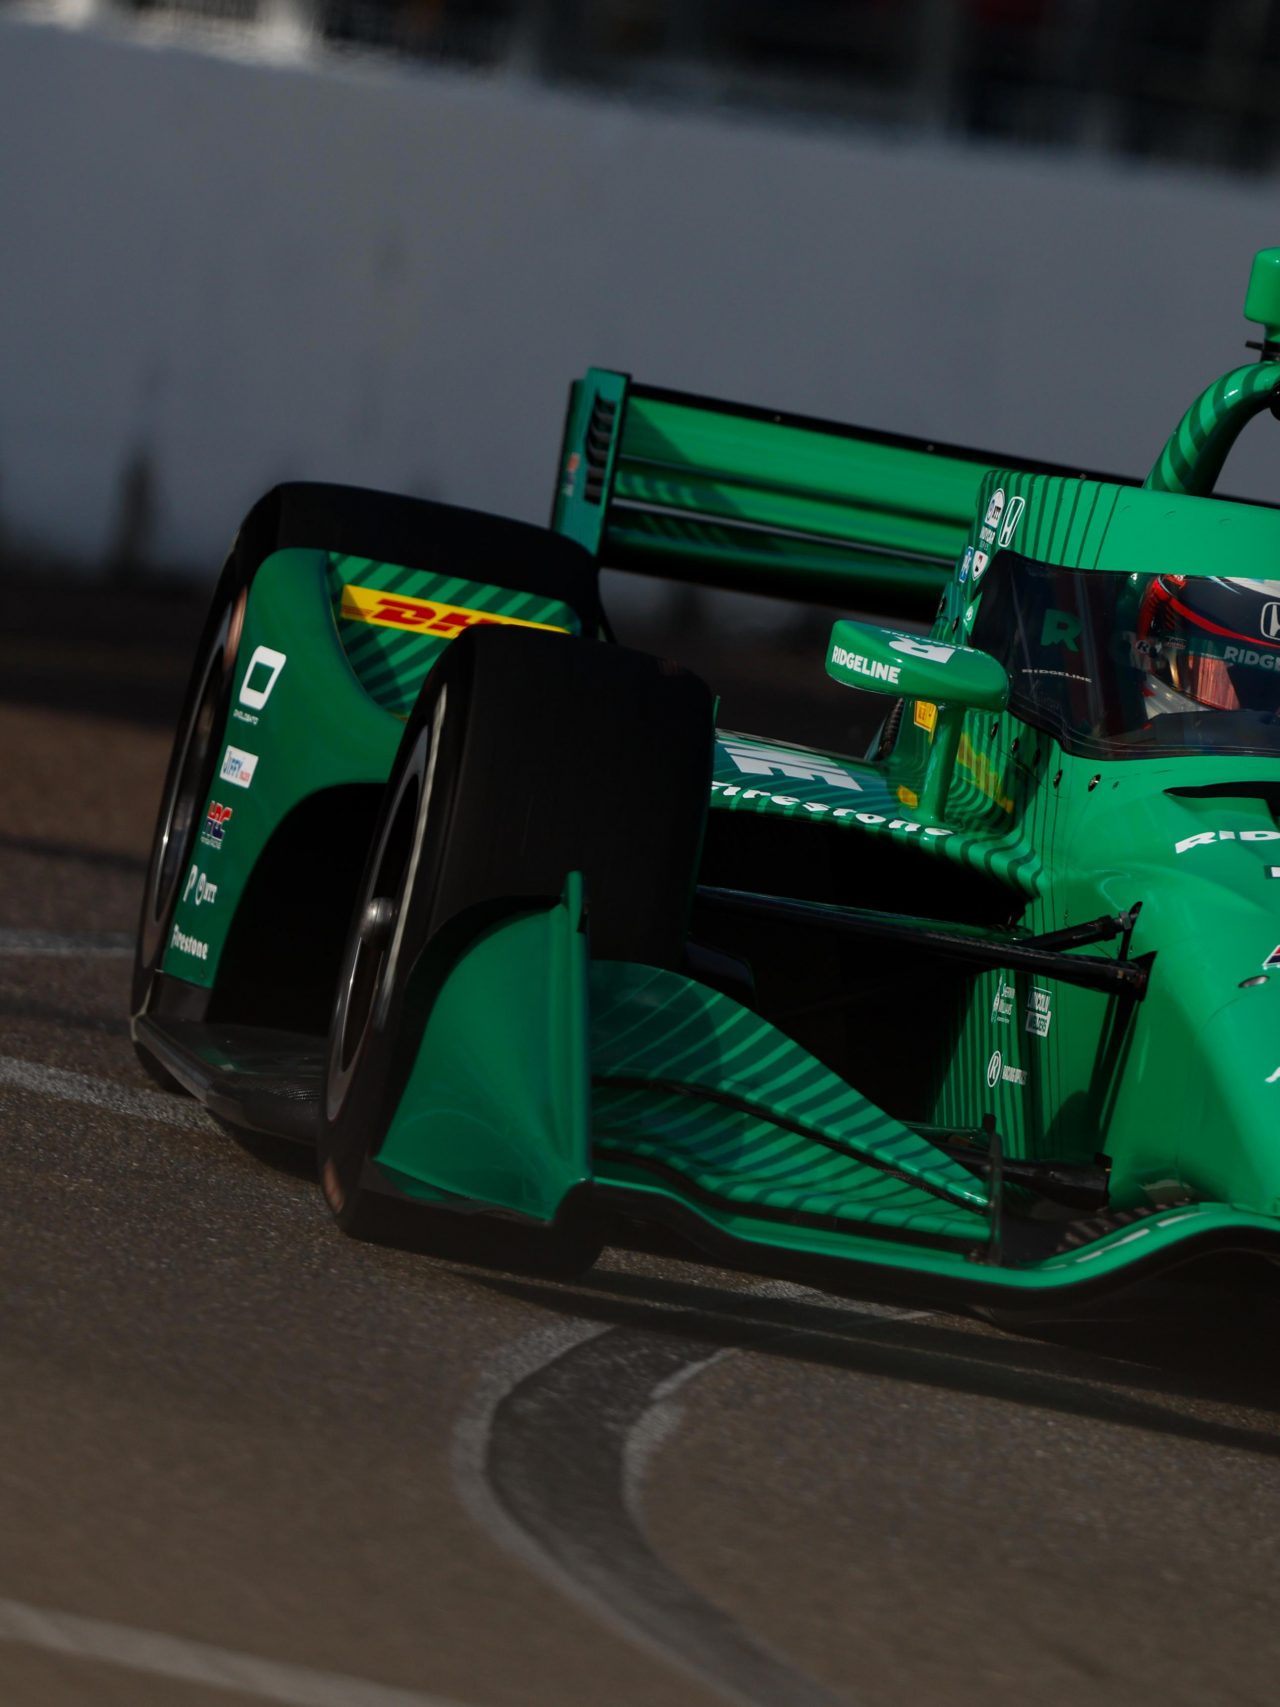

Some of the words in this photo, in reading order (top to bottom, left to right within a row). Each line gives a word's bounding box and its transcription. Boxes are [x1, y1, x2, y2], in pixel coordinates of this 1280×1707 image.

[371, 598, 498, 632] DH
[831, 644, 902, 685] RIDGELINE
[1021, 668, 1093, 684] RIDGELINE
[170, 923, 210, 961] Firestone
